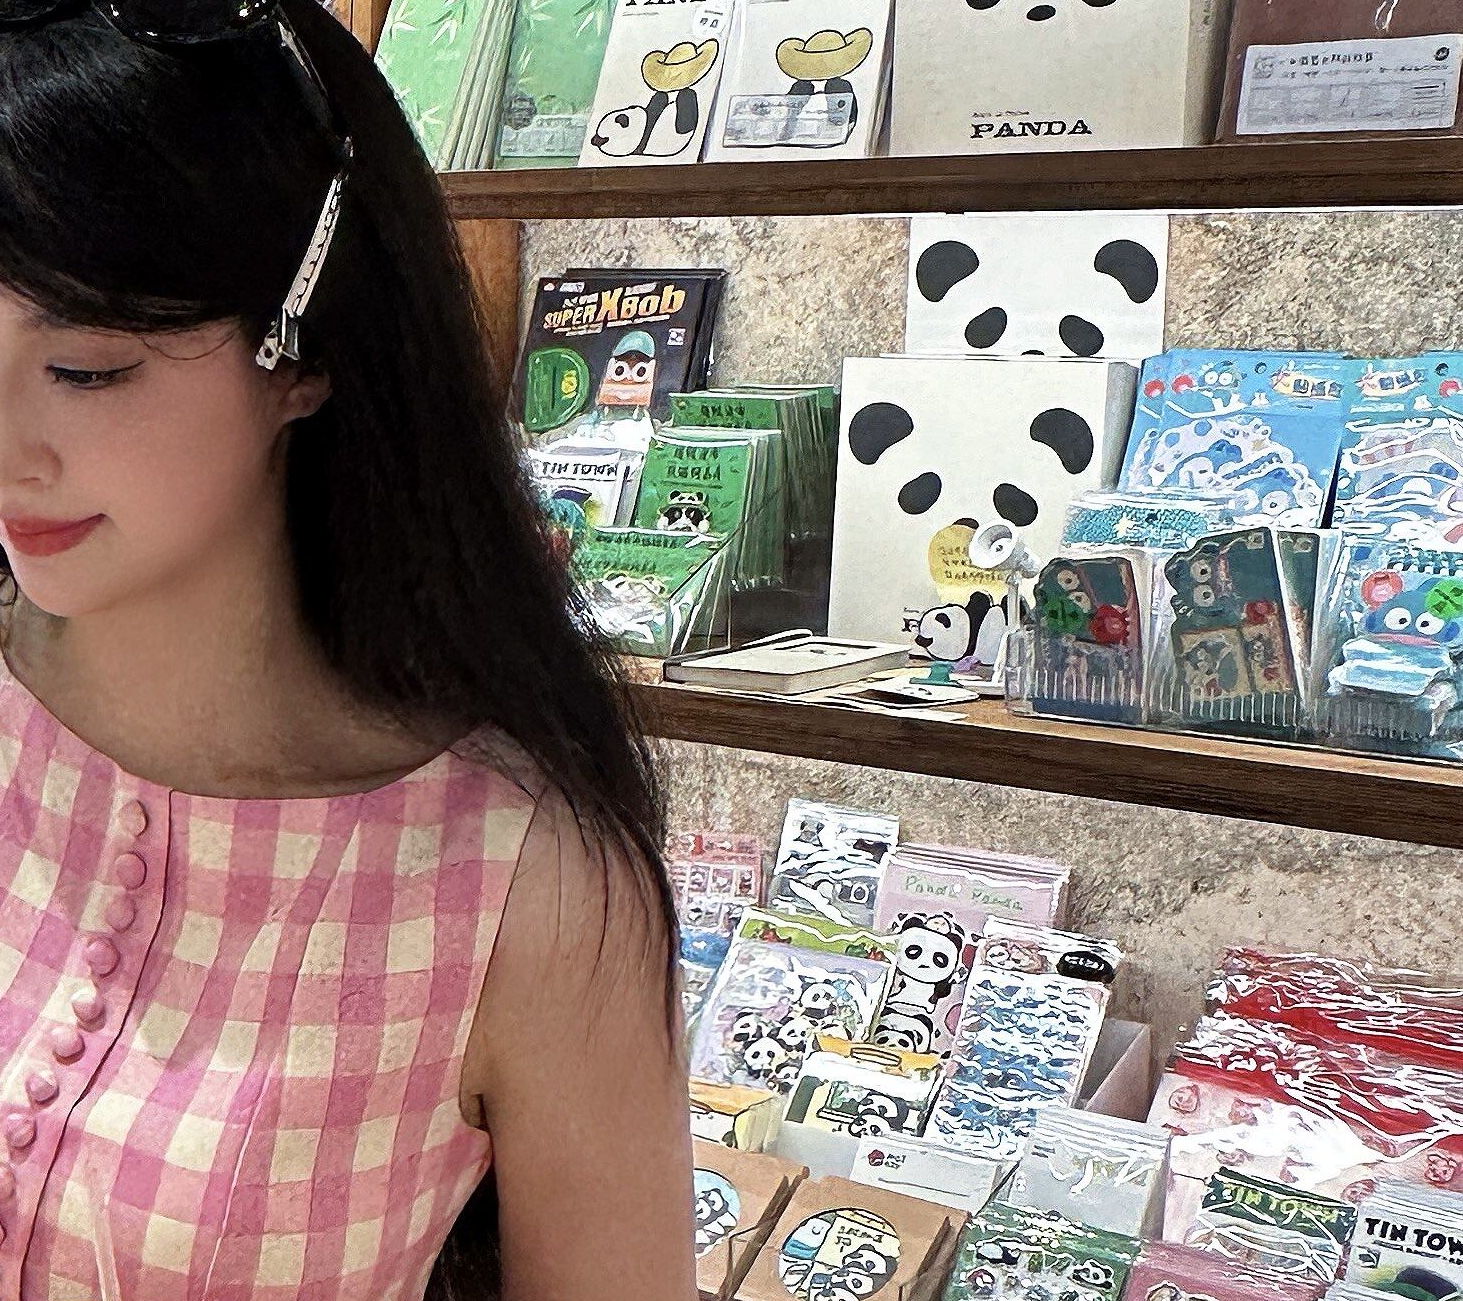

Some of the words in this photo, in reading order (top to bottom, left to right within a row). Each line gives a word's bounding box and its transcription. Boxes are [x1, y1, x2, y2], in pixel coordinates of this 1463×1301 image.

[970, 119, 1092, 139] PANDA
[543, 302, 597, 330] SUPER
[1365, 1218, 1409, 1243] TIN
